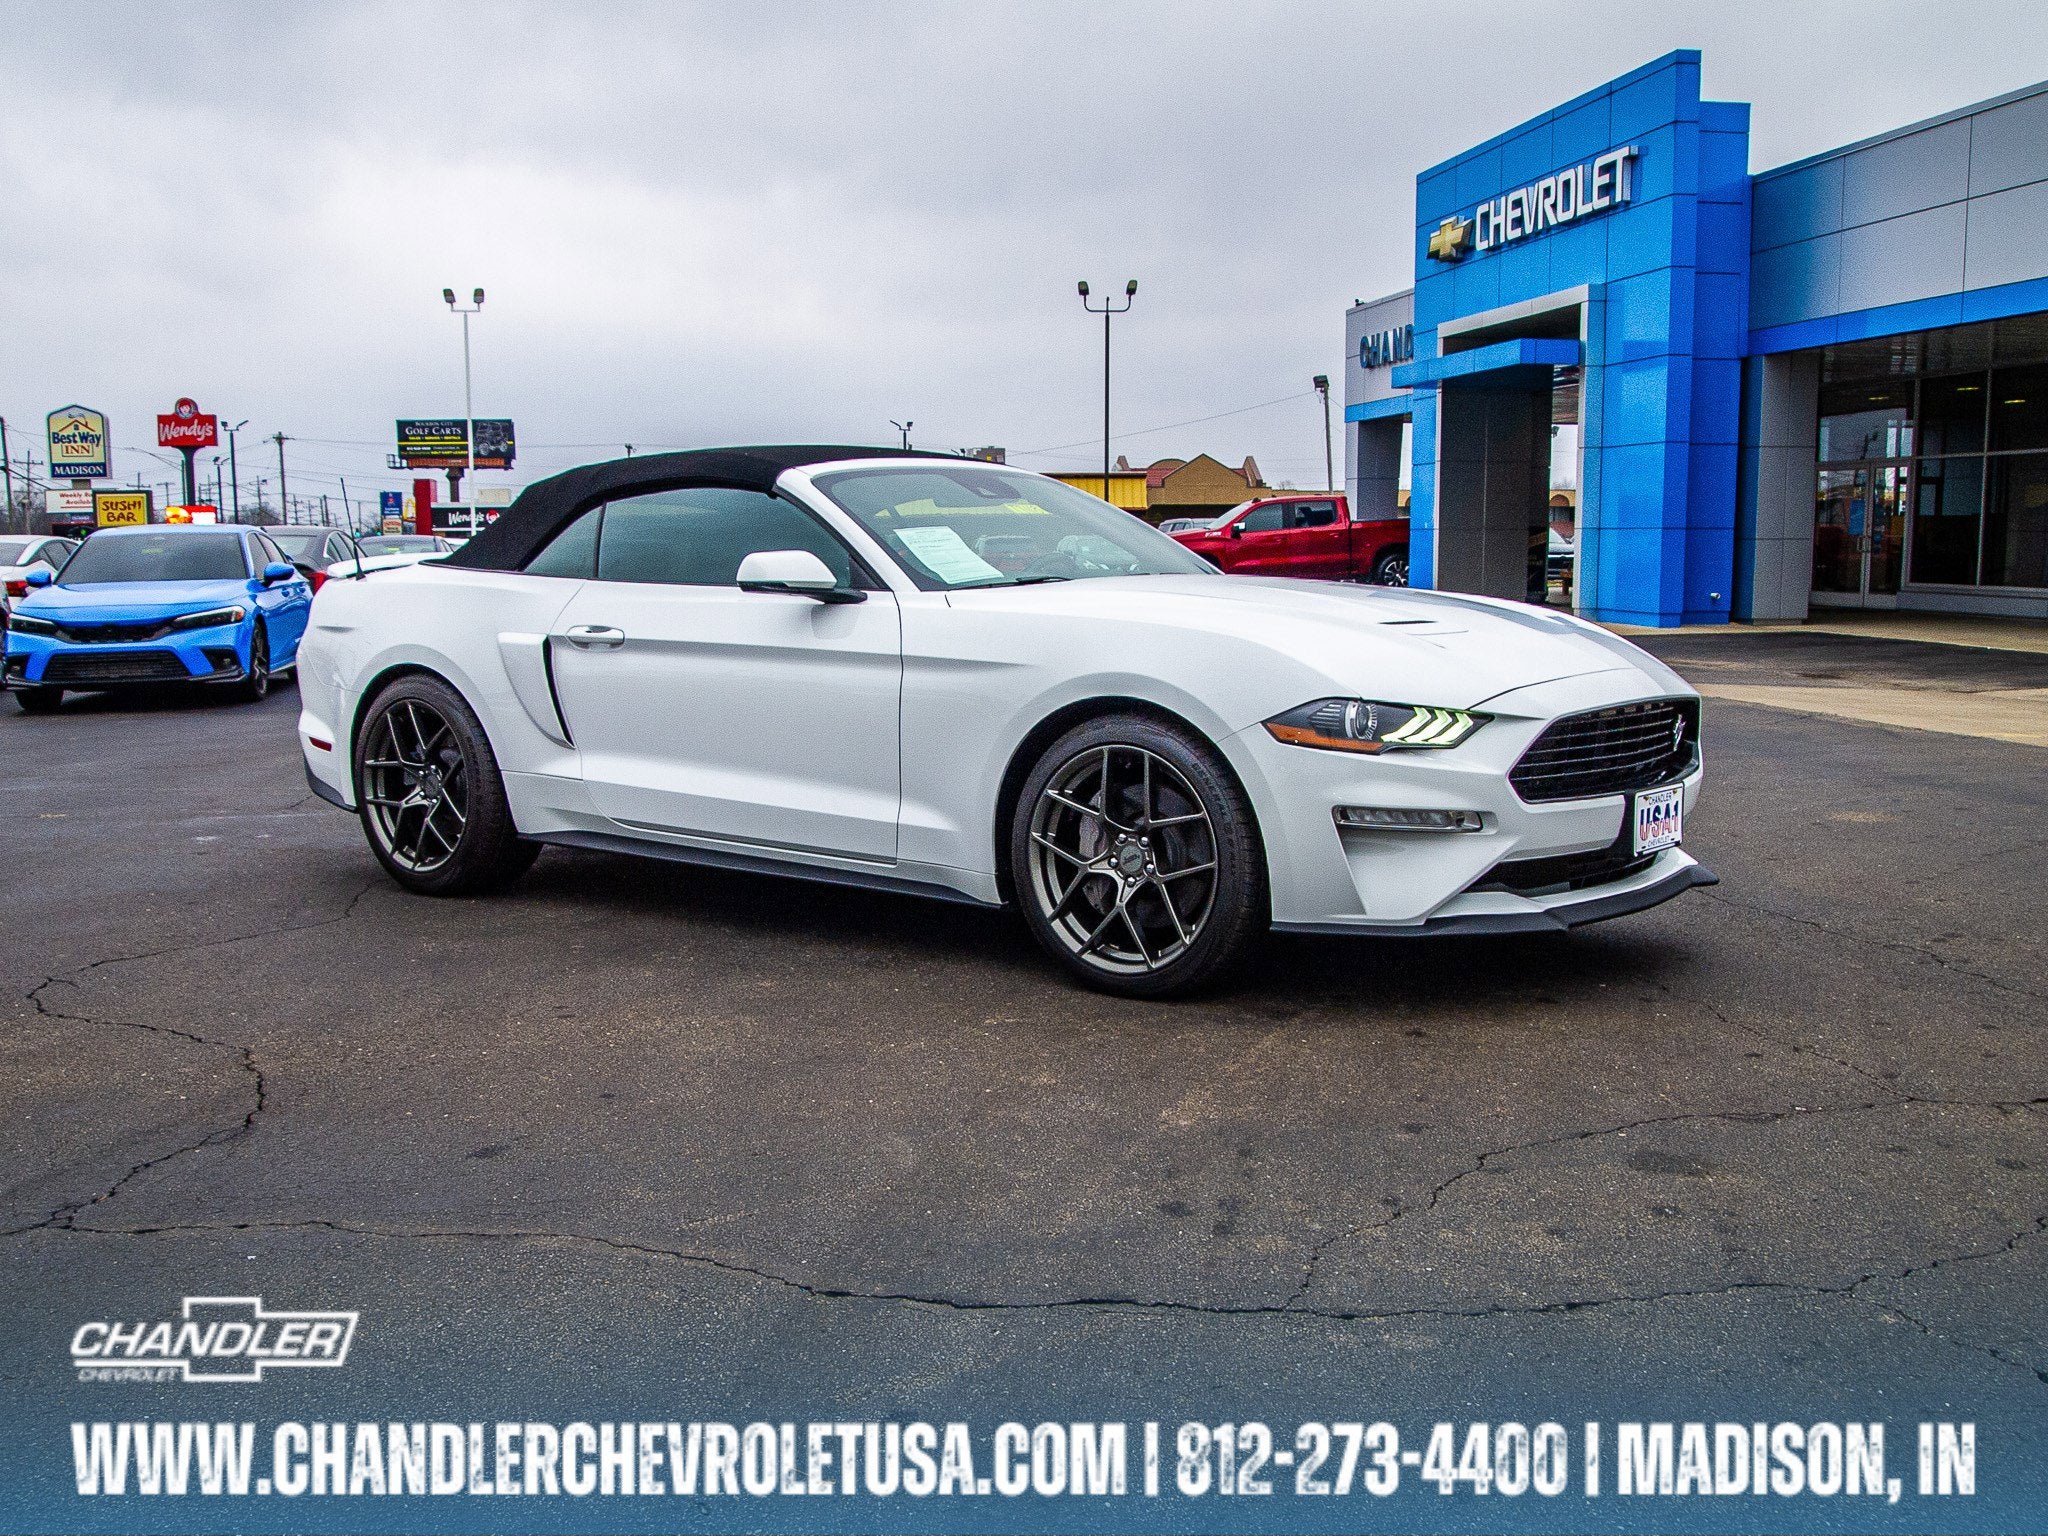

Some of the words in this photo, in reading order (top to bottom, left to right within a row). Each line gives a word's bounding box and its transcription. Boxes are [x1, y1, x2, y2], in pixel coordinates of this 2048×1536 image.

[1475, 146, 1638, 251] CHEVROLET
[160, 418, 213, 442] Wendy's
[405, 426, 430, 435] GOLF
[432, 426, 462, 435] CARTS
[52, 432, 78, 444] Best
[78, 432, 101, 447] Way
[65, 445, 90, 454] INN
[54, 465, 104, 475] MADISON
[101, 500, 142, 511] SUSHI
[106, 512, 137, 522] BAR
[1649, 792, 1672, 805] CHANDLER
